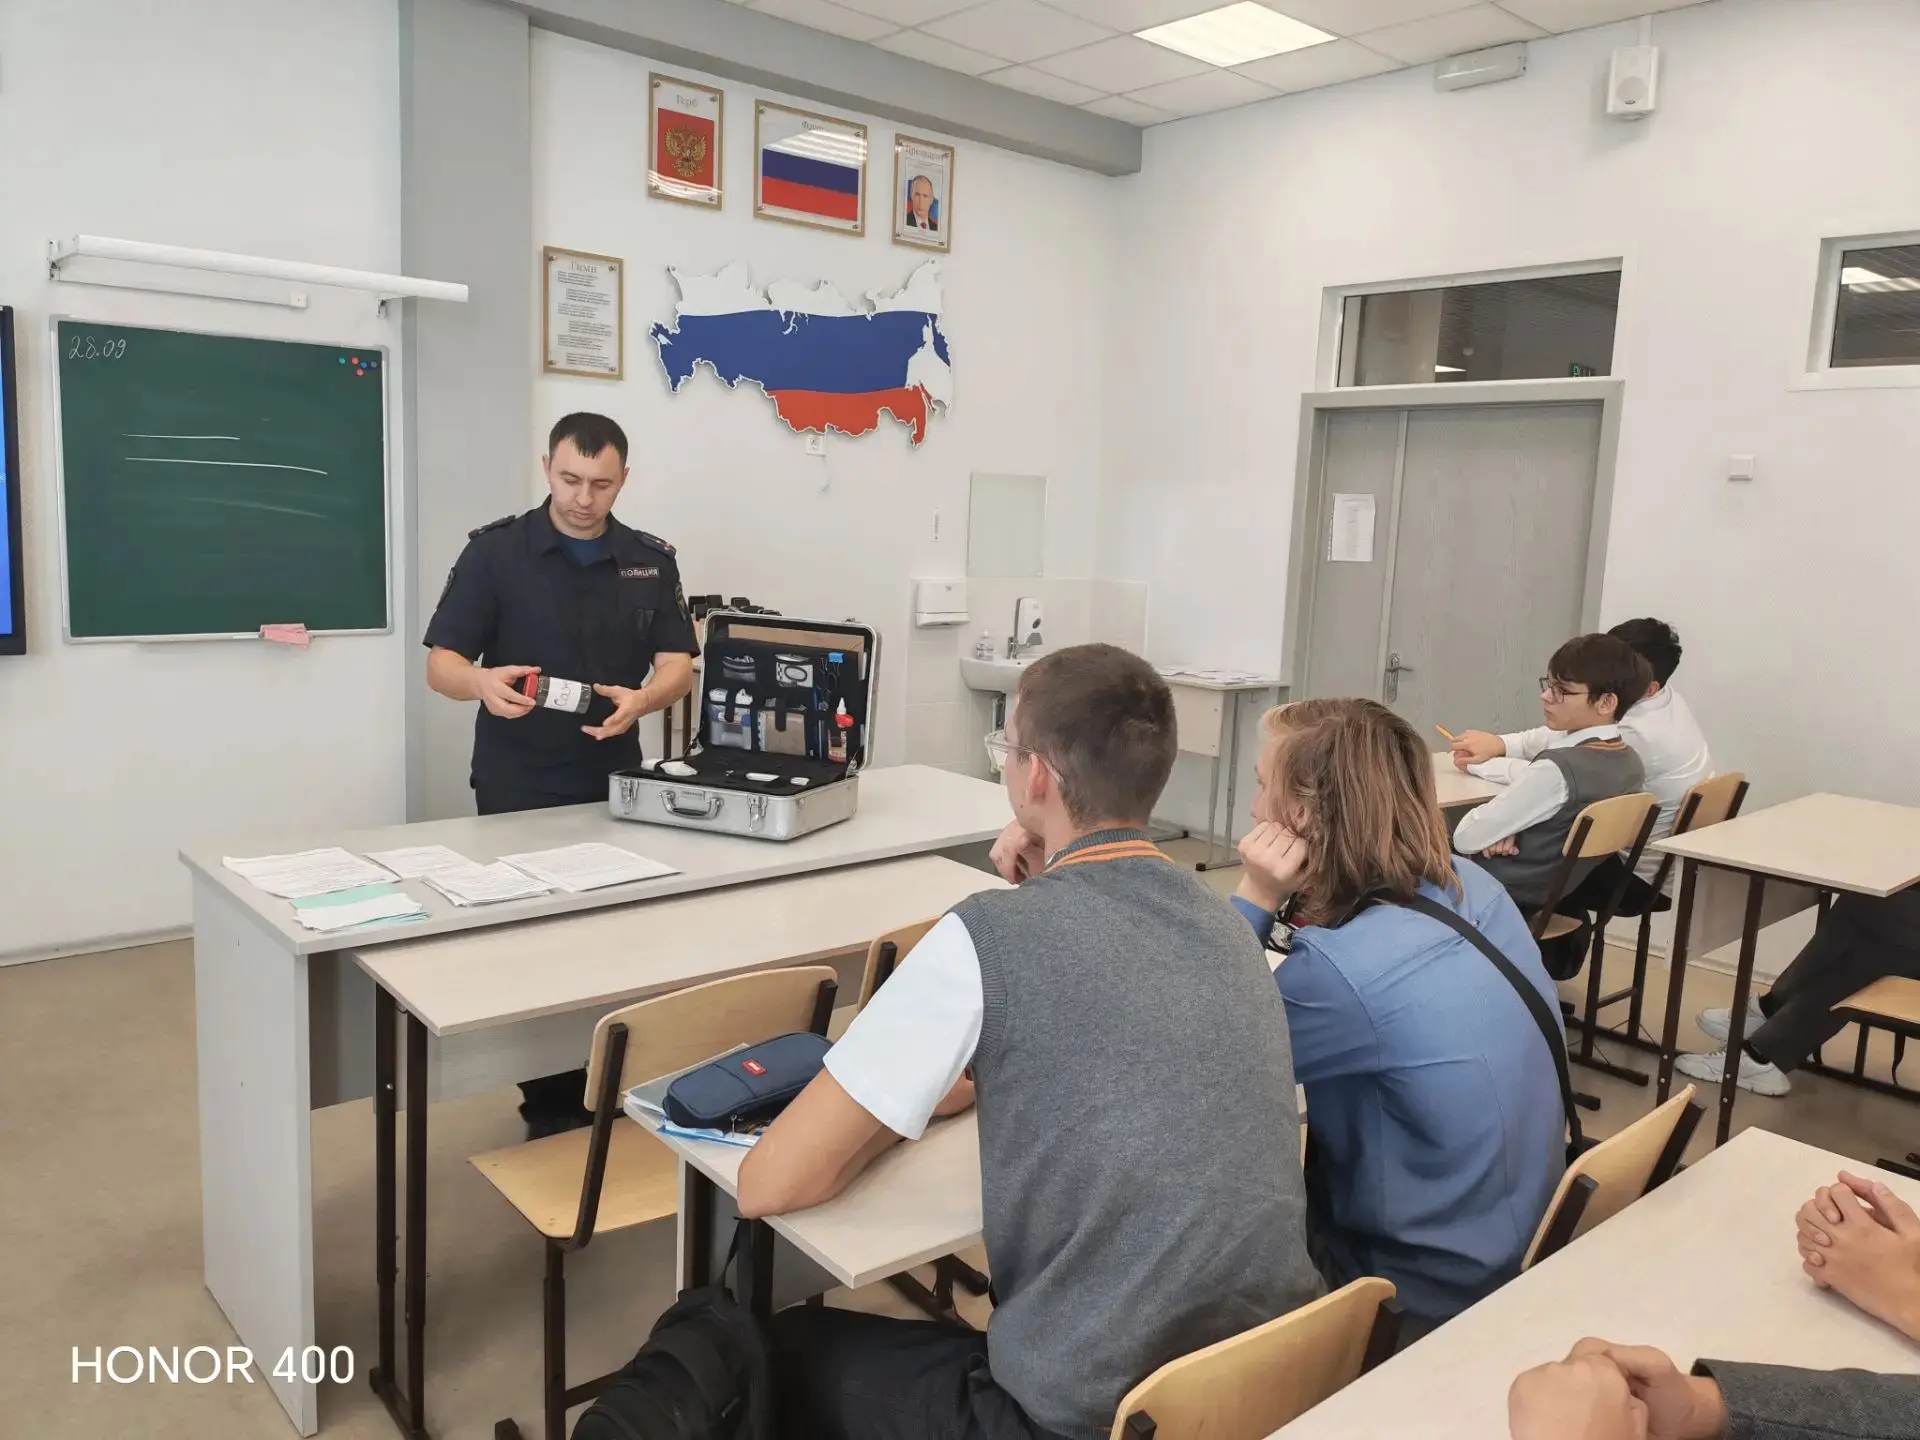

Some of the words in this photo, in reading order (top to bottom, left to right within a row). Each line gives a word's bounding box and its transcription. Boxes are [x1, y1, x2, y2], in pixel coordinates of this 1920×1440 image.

[676, 94, 698, 109] Герб
[571, 261, 597, 273] Гимн
[68, 335, 127, 360] 28.09
[620, 568, 658, 577] ПОЛИЦИЯ
